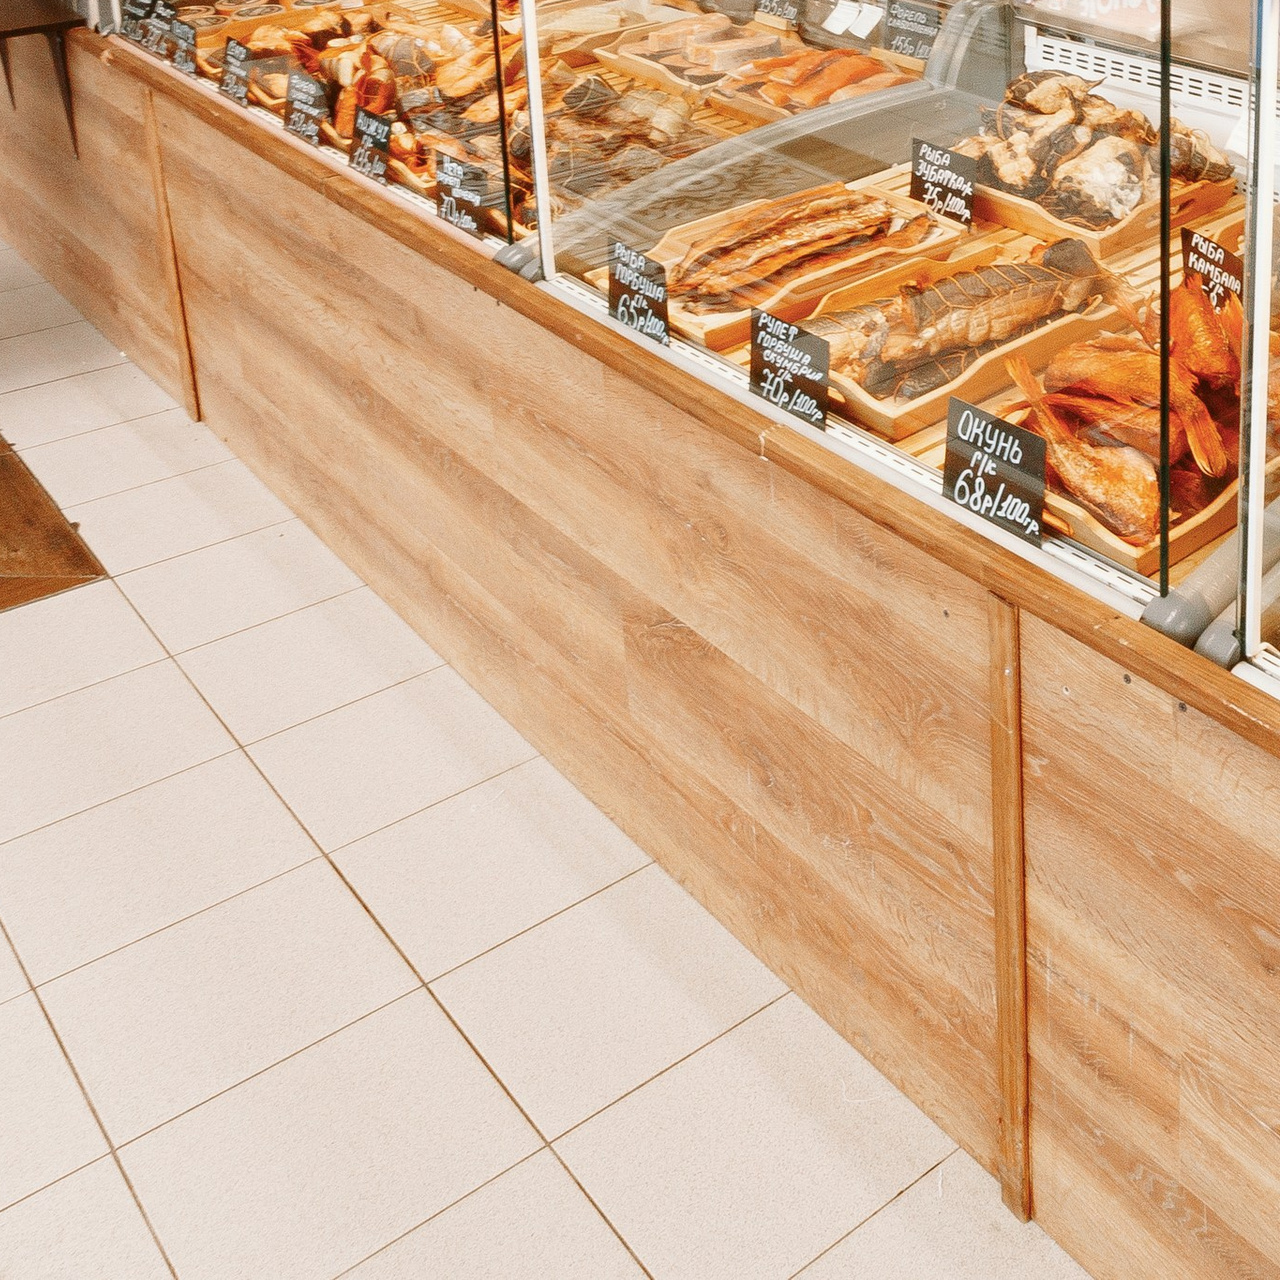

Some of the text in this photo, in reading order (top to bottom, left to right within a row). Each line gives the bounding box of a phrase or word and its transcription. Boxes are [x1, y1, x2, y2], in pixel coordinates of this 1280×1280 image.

[919, 143, 951, 166] РЫБА
[614, 242, 645, 269] РЫБА
[1191, 233, 1225, 265] РЫБА
[614, 264, 666, 303] ГОРБУША
[1188, 252, 1242, 295] КАМБАЛА
[759, 313, 798, 342] РУЛЕТ
[757, 331, 812, 366] ГОРБУША
[763, 349, 823, 381] СКУМБРИЯ
[957, 410, 1023, 464] ОКУНЬ
[970, 451, 997, 476] г/к
